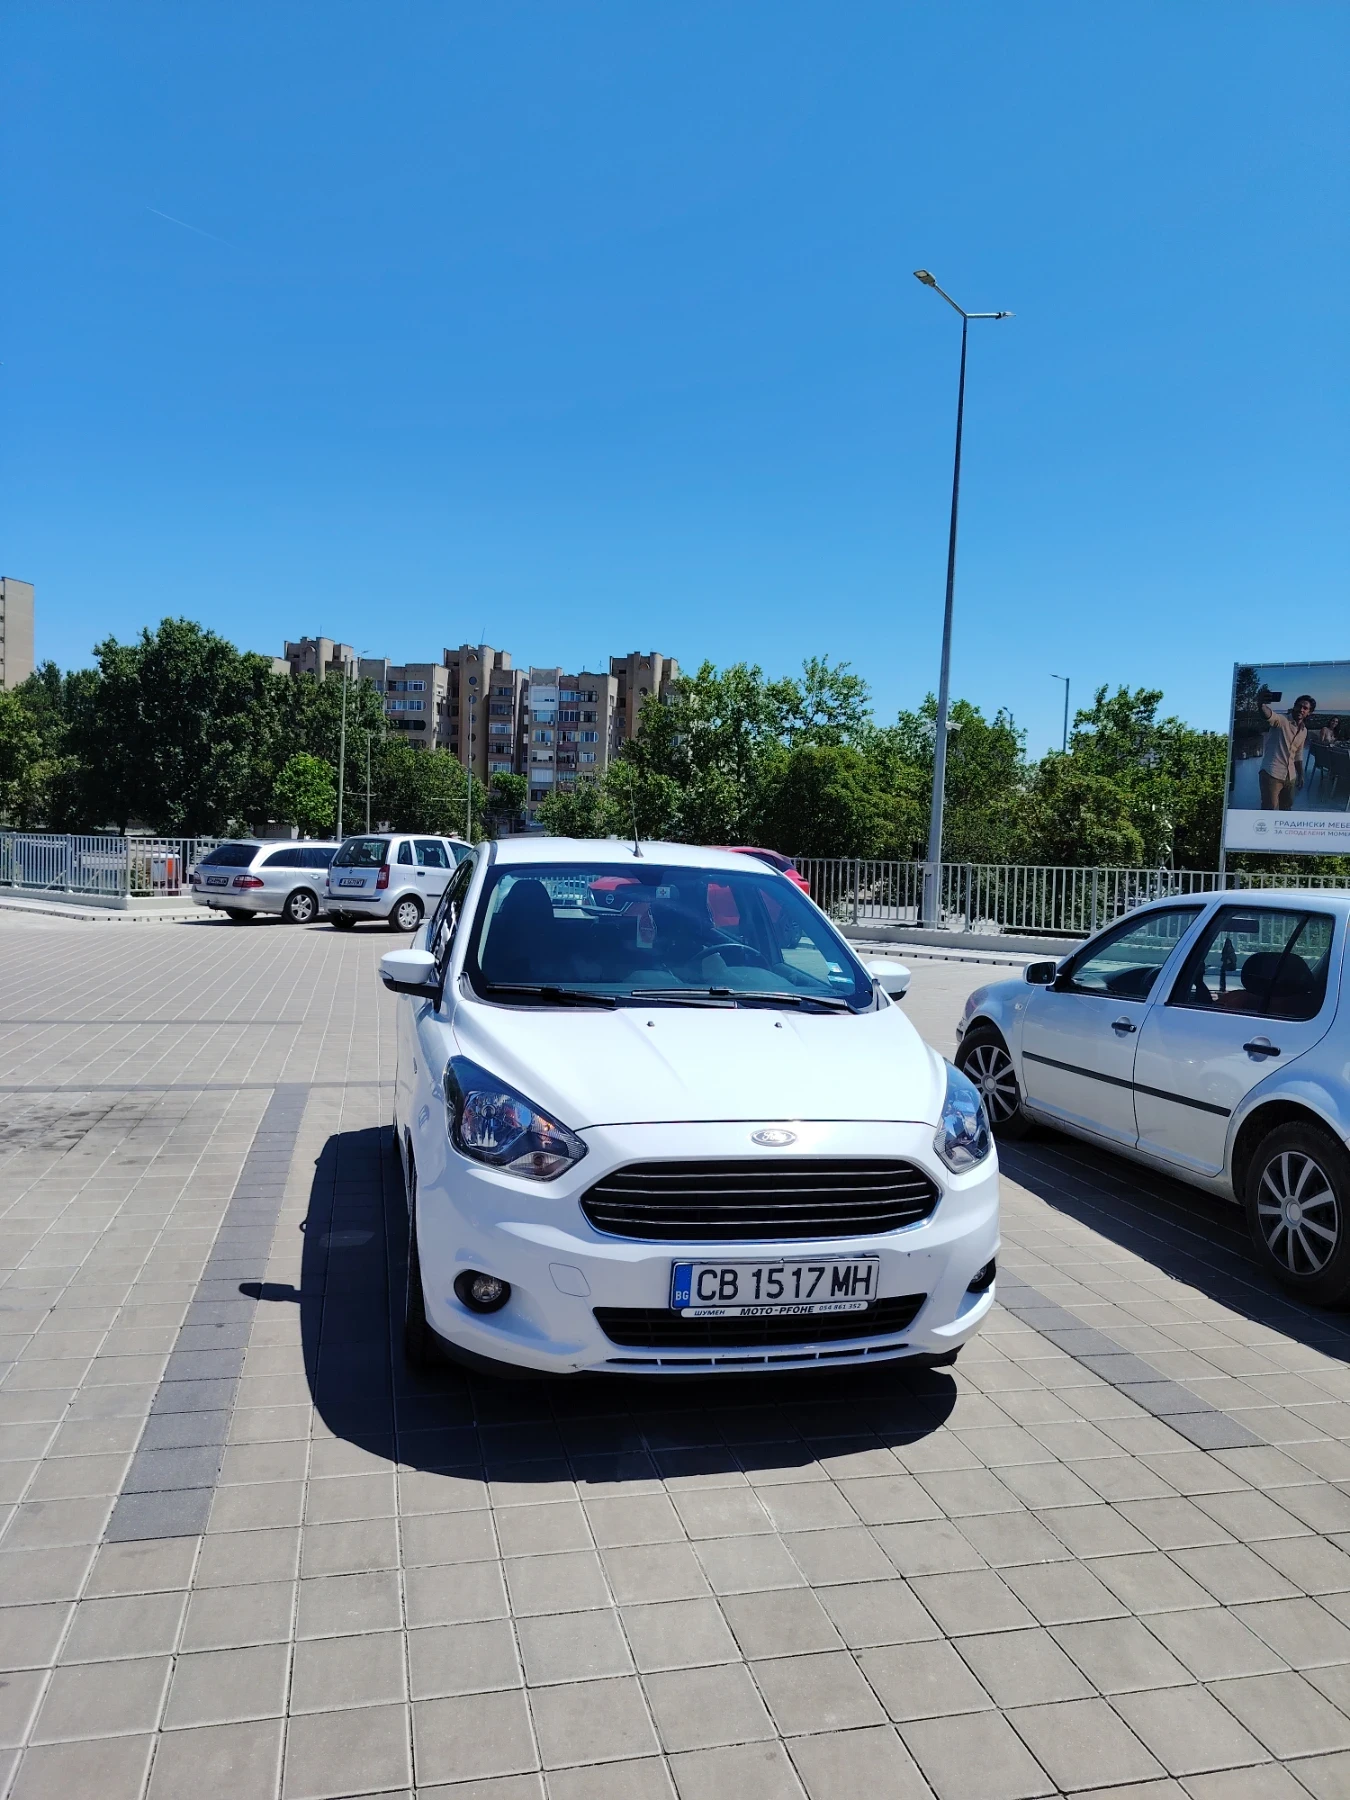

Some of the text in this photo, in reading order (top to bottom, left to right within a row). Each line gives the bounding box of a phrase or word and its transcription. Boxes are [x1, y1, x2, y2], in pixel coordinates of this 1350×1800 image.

[1274, 820, 1325, 828] ГРАДИНСКИ
[696, 1264, 873, 1301] CB 1517 MH
[675, 1290, 689, 1301] BG
[693, 1309, 726, 1317] ШУМЕН
